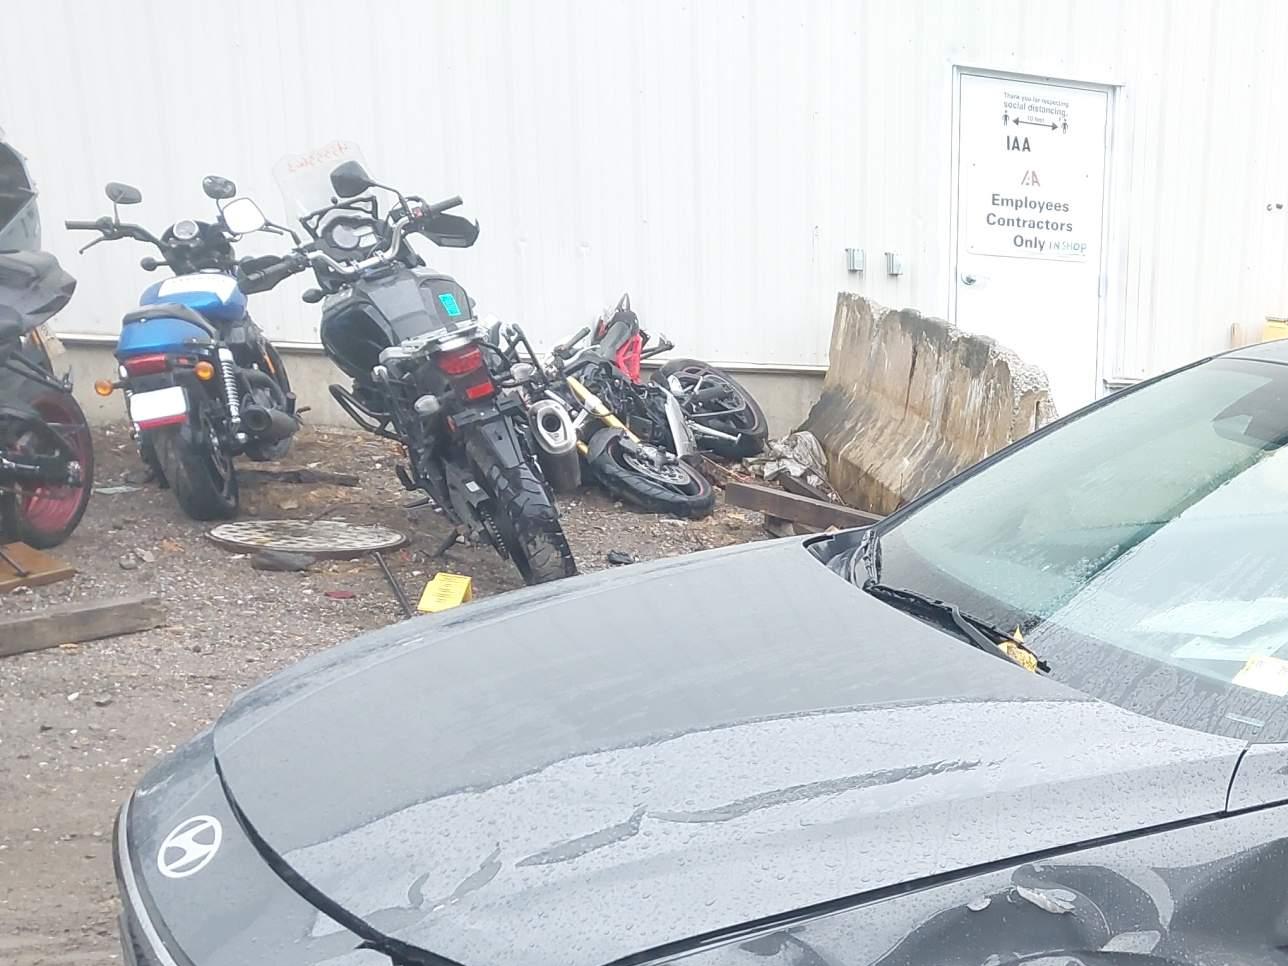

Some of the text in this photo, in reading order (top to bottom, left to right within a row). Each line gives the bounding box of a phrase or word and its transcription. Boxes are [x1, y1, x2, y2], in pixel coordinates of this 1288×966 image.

[1003, 101, 1026, 110] social
[1006, 135, 1032, 152] IAA
[991, 193, 1070, 213] Employees
[986, 212, 1073, 232] Contractors
[1013, 234, 1046, 252] Only
